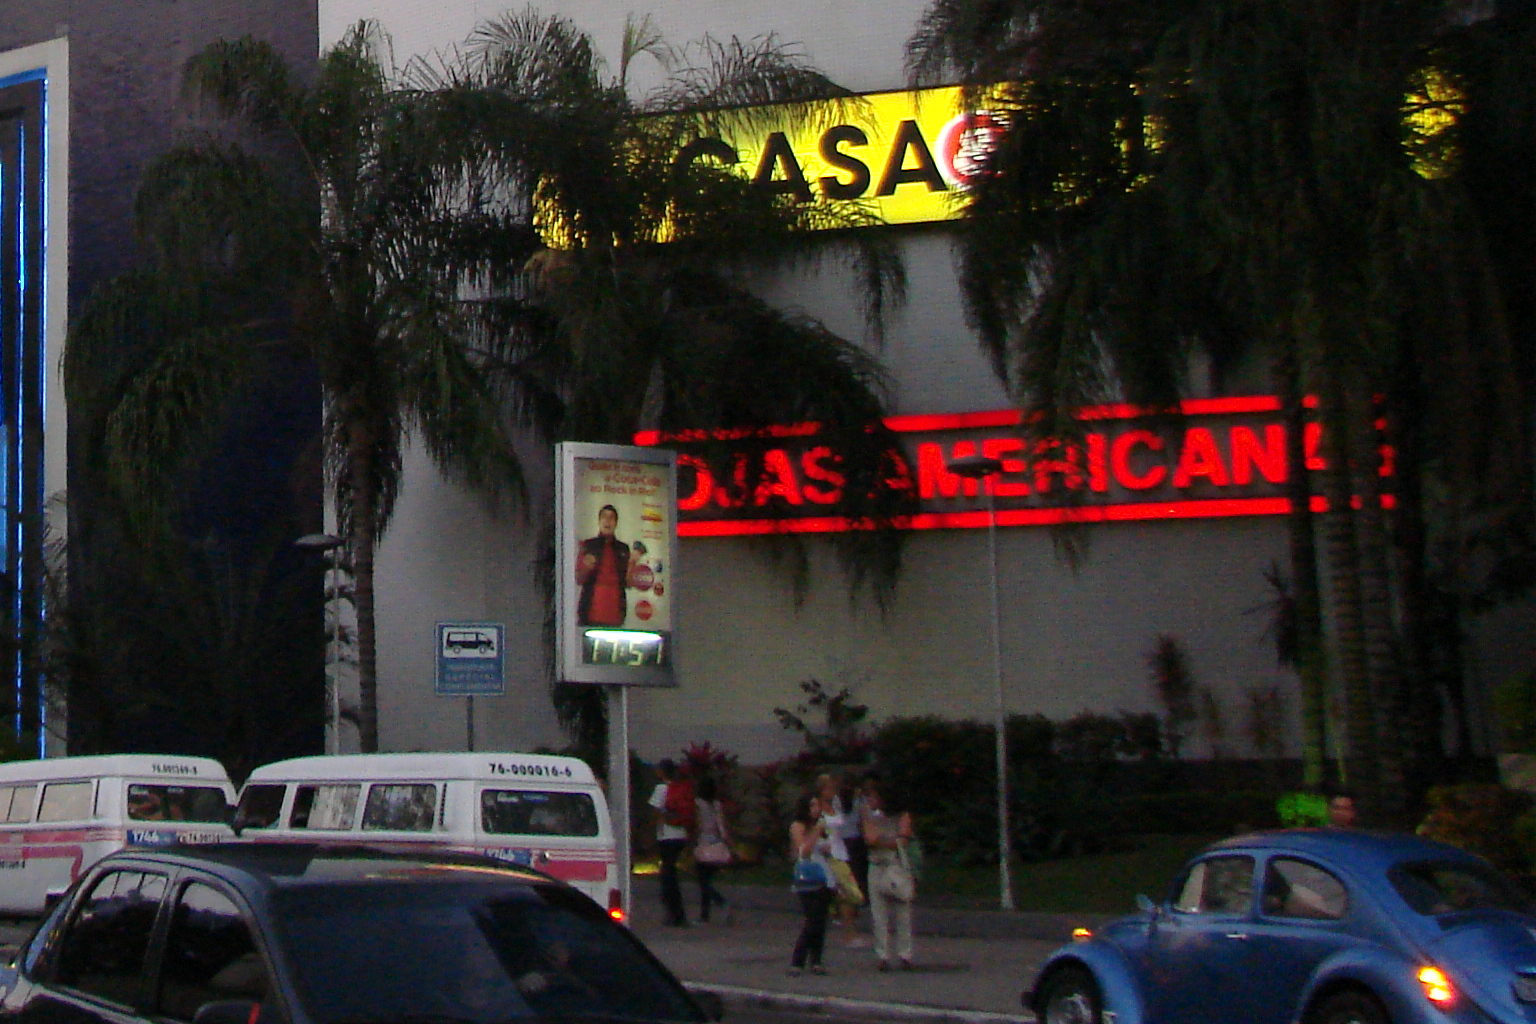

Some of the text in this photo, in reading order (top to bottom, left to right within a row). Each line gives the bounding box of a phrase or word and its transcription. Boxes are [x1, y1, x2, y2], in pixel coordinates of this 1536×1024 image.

[676, 420, 1398, 510] OJAS MERICAN
[488, 762, 573, 778] 76-000016-6
